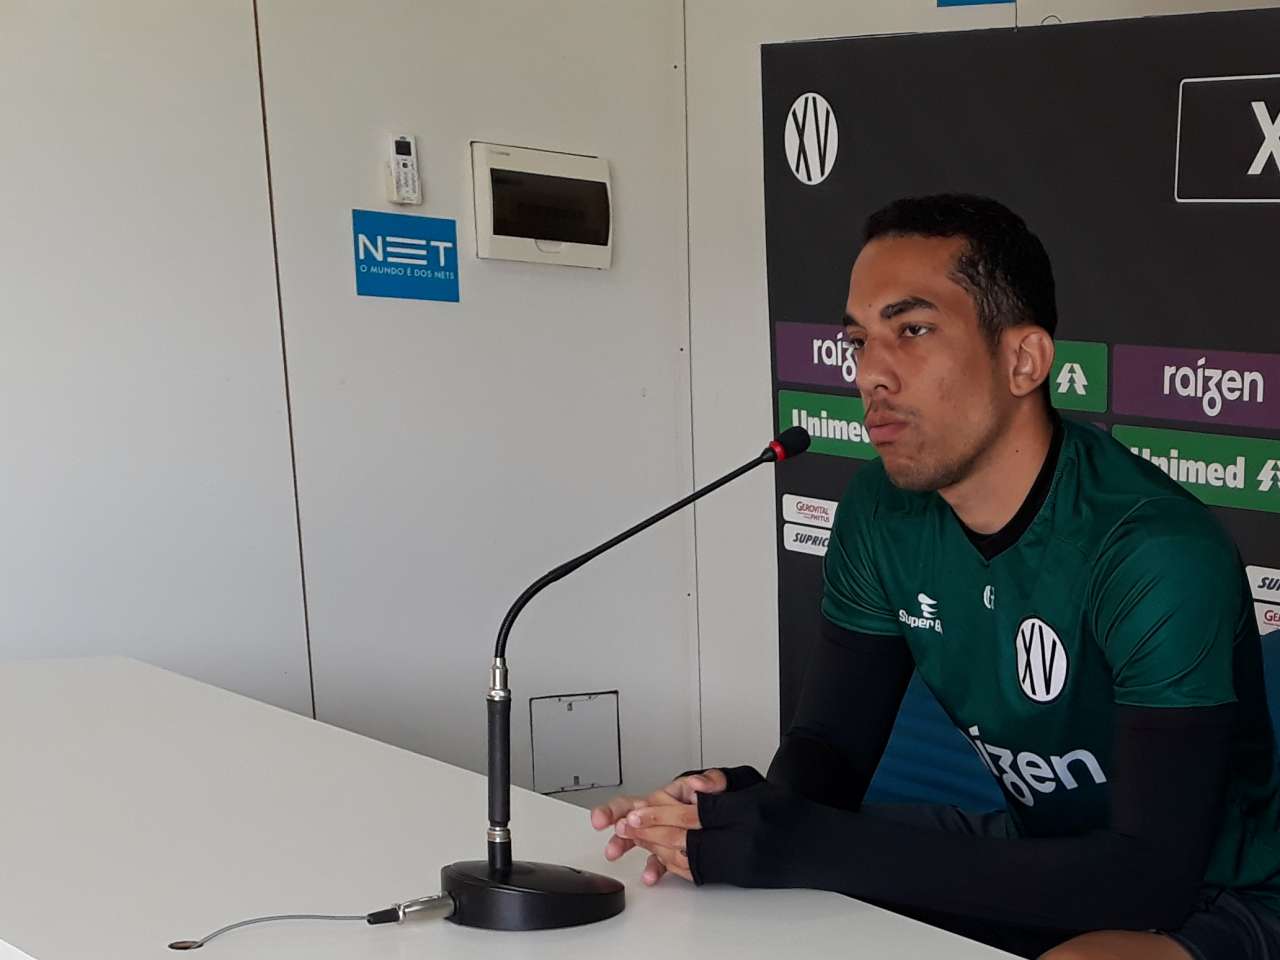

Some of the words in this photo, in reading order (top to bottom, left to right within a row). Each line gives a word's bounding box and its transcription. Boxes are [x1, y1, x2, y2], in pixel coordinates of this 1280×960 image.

[791, 95, 831, 182] XV
[358, 234, 453, 268] NET
[370, 265, 404, 276] MUNDO
[414, 269, 432, 278] DOS
[813, 332, 858, 382] raíz
[791, 408, 870, 443] Unime
[793, 532, 830, 548] SUPRIC
[899, 609, 935, 629] Super
